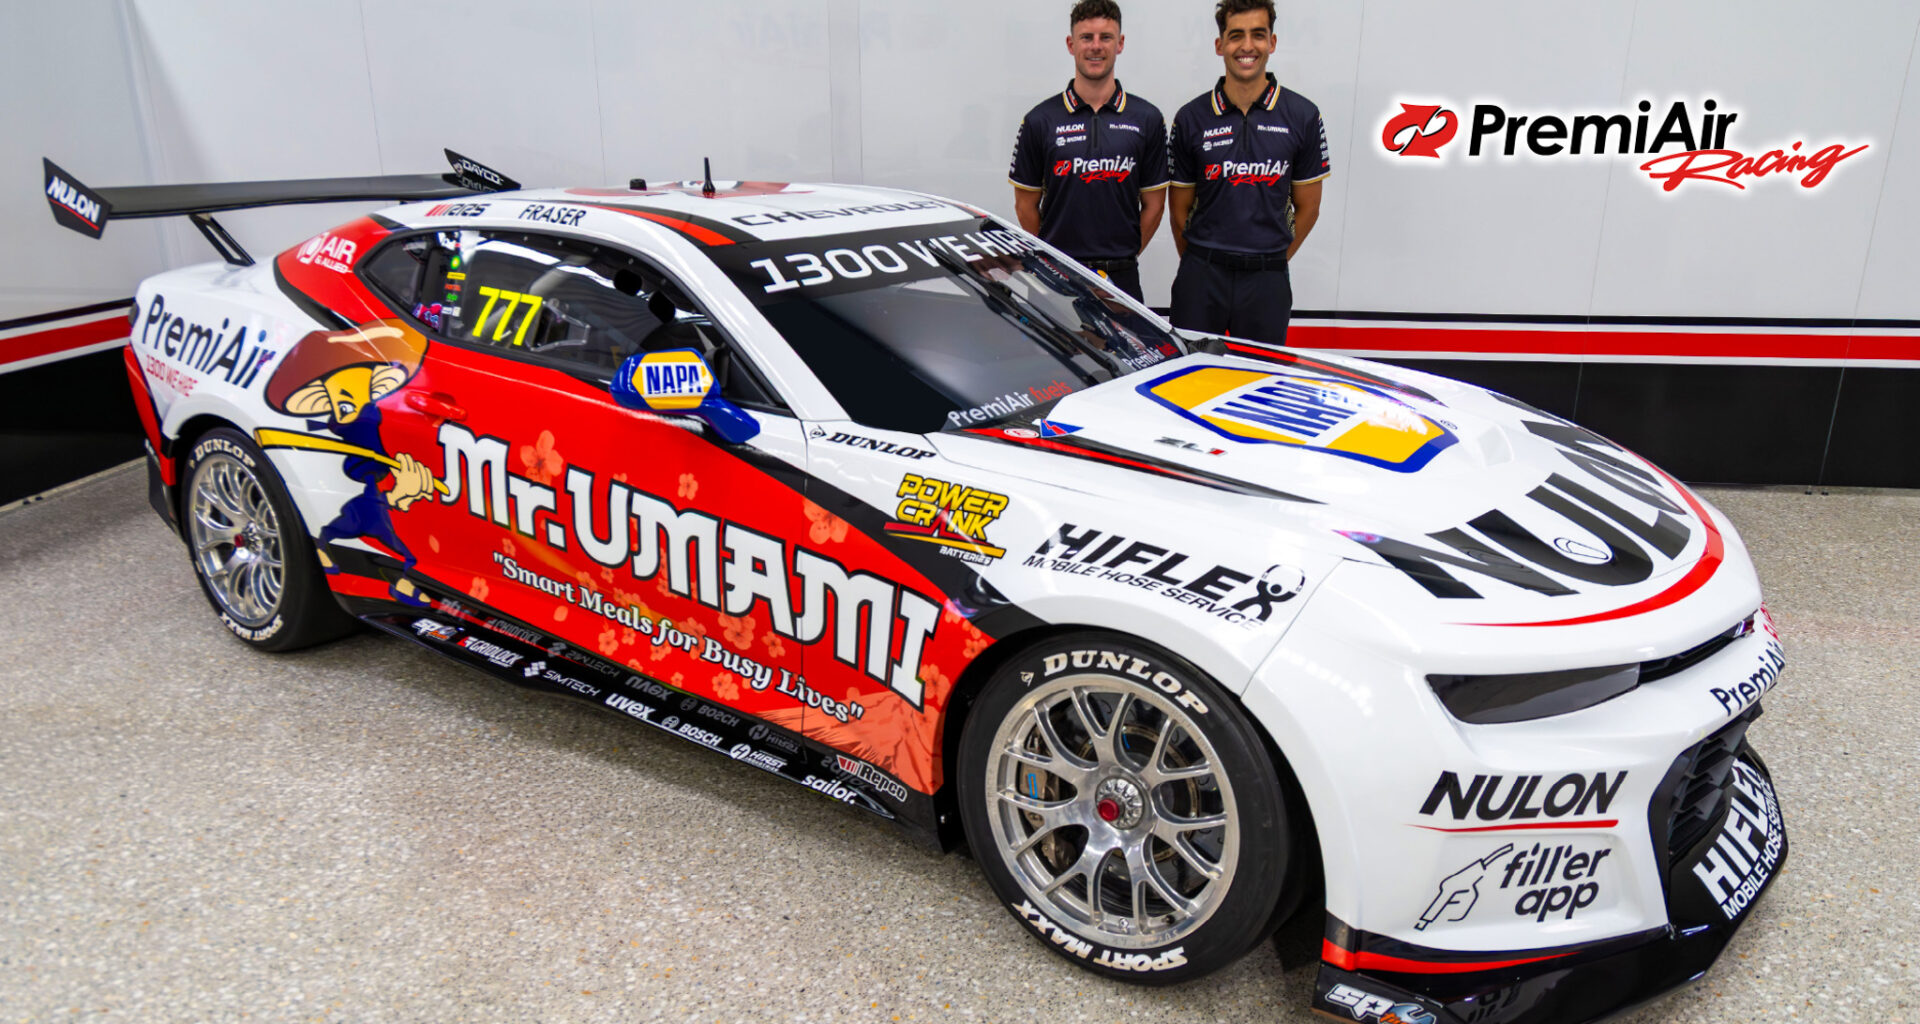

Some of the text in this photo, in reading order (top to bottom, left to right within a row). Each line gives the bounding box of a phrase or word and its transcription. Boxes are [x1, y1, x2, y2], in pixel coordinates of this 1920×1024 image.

[1056, 123, 1085, 133] NULON
[1203, 126, 1233, 138] NULON
[461, 159, 502, 185] DAYCO
[1073, 155, 1136, 174] PremiAir
[1223, 159, 1290, 177] PremiAir
[47, 175, 101, 223] NULON
[518, 204, 587, 227] FRASER
[732, 201, 946, 226] CHEVROLET
[320, 236, 357, 265] AIR
[750, 245, 908, 294] 1300
[898, 236, 984, 267] WE
[472, 286, 543, 346] 777
[142, 294, 276, 389] PremiAir
[645, 365, 702, 394] NAPA
[948, 380, 1073, 427] PremiAir fuels
[1211, 381, 1362, 438] NAPA
[195, 438, 256, 468] DUNLOP
[827, 432, 936, 460] DUNLOP
[897, 473, 1009, 518] POWER
[1331, 420, 1691, 599] NULON
[897, 498, 993, 541] CRANK
[939, 546, 993, 566] BATTERIES
[1035, 523, 1297, 622] HIFLEX
[1022, 555, 1263, 630] MOBILE HOSE SERVICE
[469, 641, 523, 666] GRIDLOCK
[578, 585, 652, 636] Meals
[653, 618, 698, 652] for
[700, 639, 775, 690] Busy
[776, 668, 865, 723] Lives"
[543, 670, 600, 697] SIMTECH
[1043, 650, 1210, 715] DUNLOP
[605, 693, 657, 720] uvex
[679, 723, 723, 746] BOSCH
[749, 751, 787, 769] HIRST
[859, 761, 907, 802] Repco
[1419, 770, 1629, 821] NULON
[1721, 862, 1769, 920] MOBILE
[1761, 824, 1782, 870] HOSE
[1515, 881, 1599, 922] app
[1011, 900, 1094, 960] MAXX
[1093, 946, 1188, 972] SPORT
